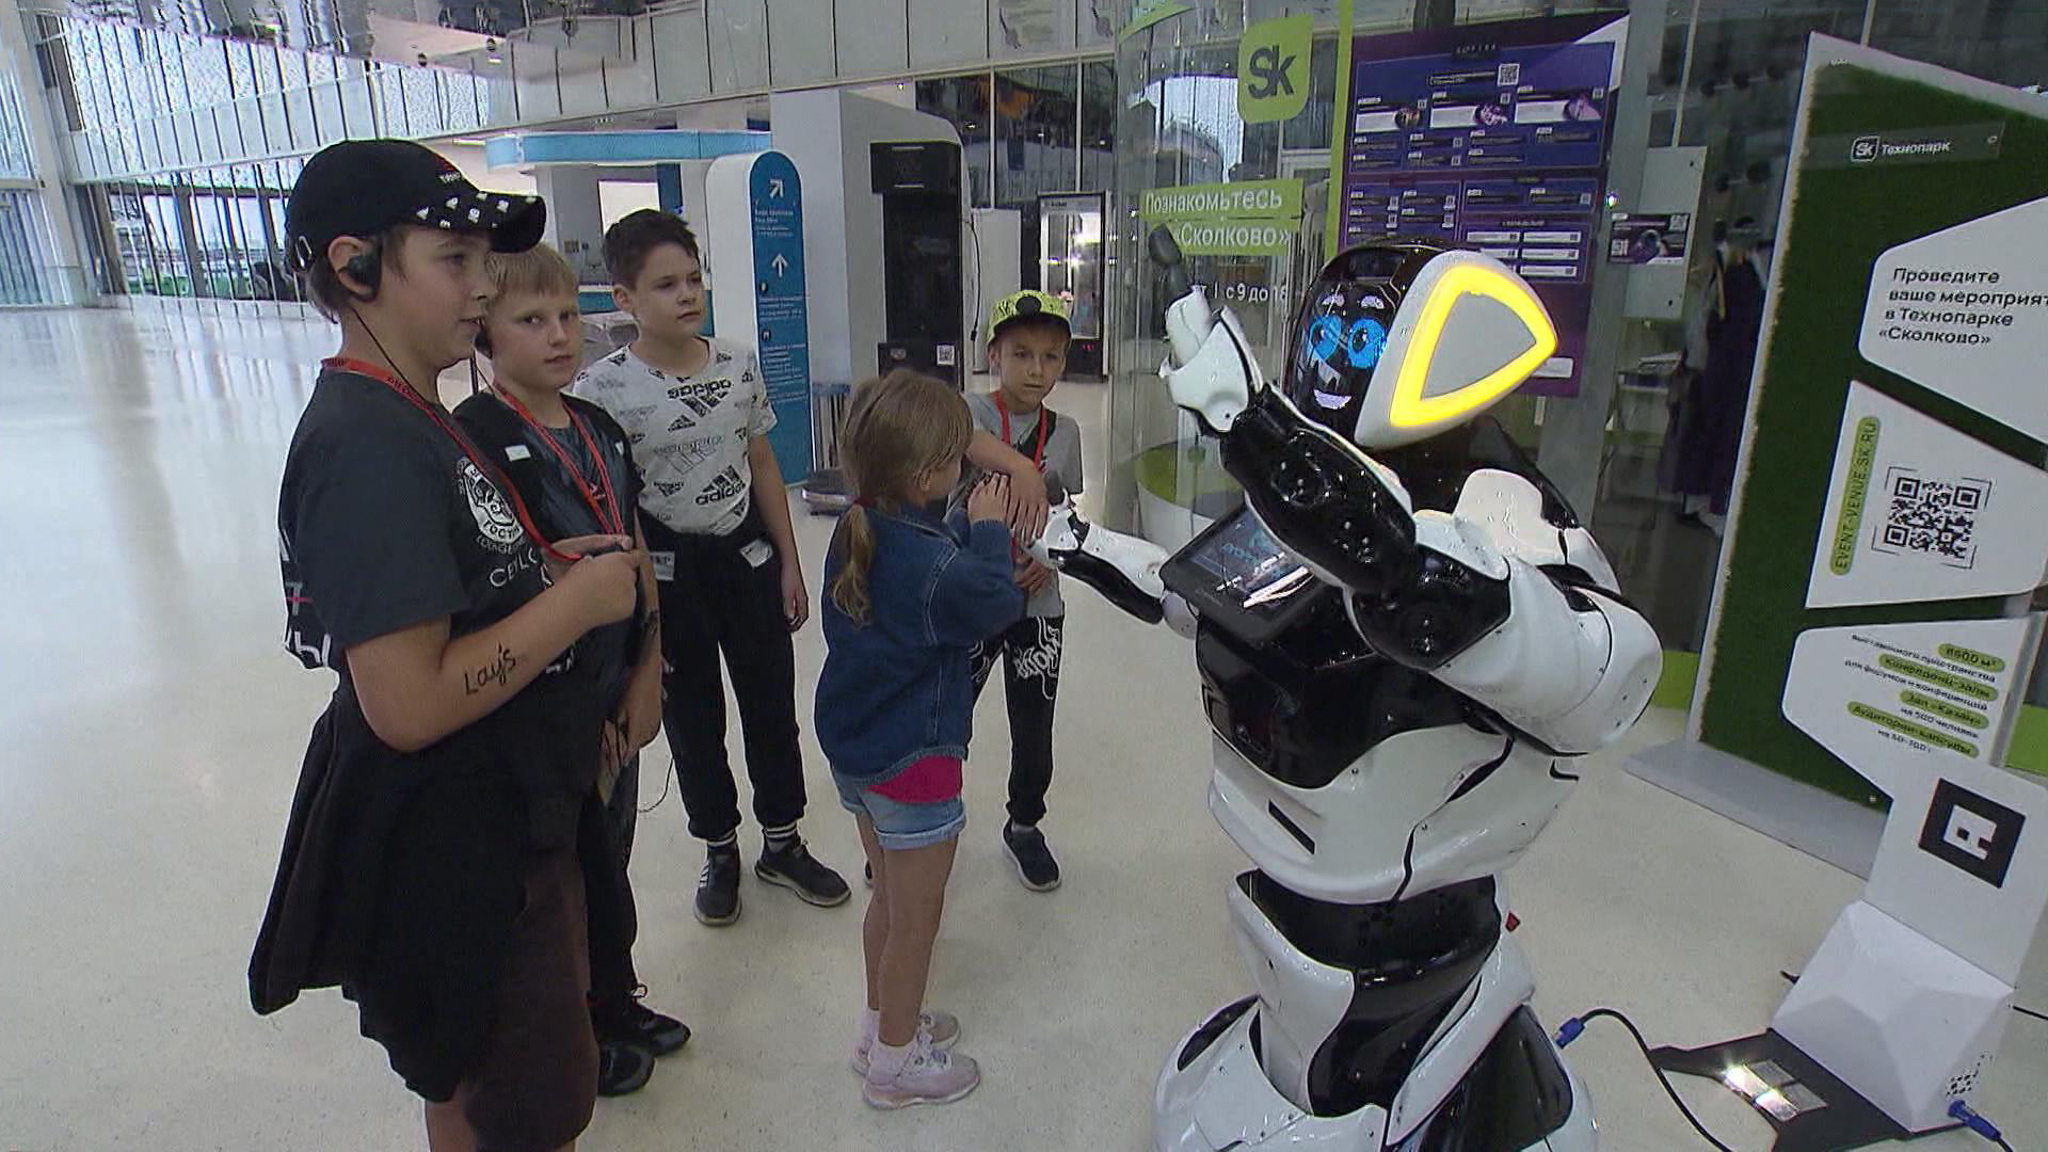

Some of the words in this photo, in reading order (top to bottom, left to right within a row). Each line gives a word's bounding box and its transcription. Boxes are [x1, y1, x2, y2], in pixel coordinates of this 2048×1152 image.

[1248, 44, 1296, 99] Sk
[1881, 140, 1951, 157] Технопарк
[1145, 188, 1282, 215] Познакомьтесь
[1892, 267, 2000, 284] Проведите
[1889, 289, 1936, 303] ваше
[1885, 309, 1895, 321] в
[1900, 307, 2014, 327] Технопарке
[1879, 326, 1991, 345] «Сколково»
[695, 478, 746, 506] adidas
[1835, 421, 1877, 569] EVENT-VENUE.SK.RU
